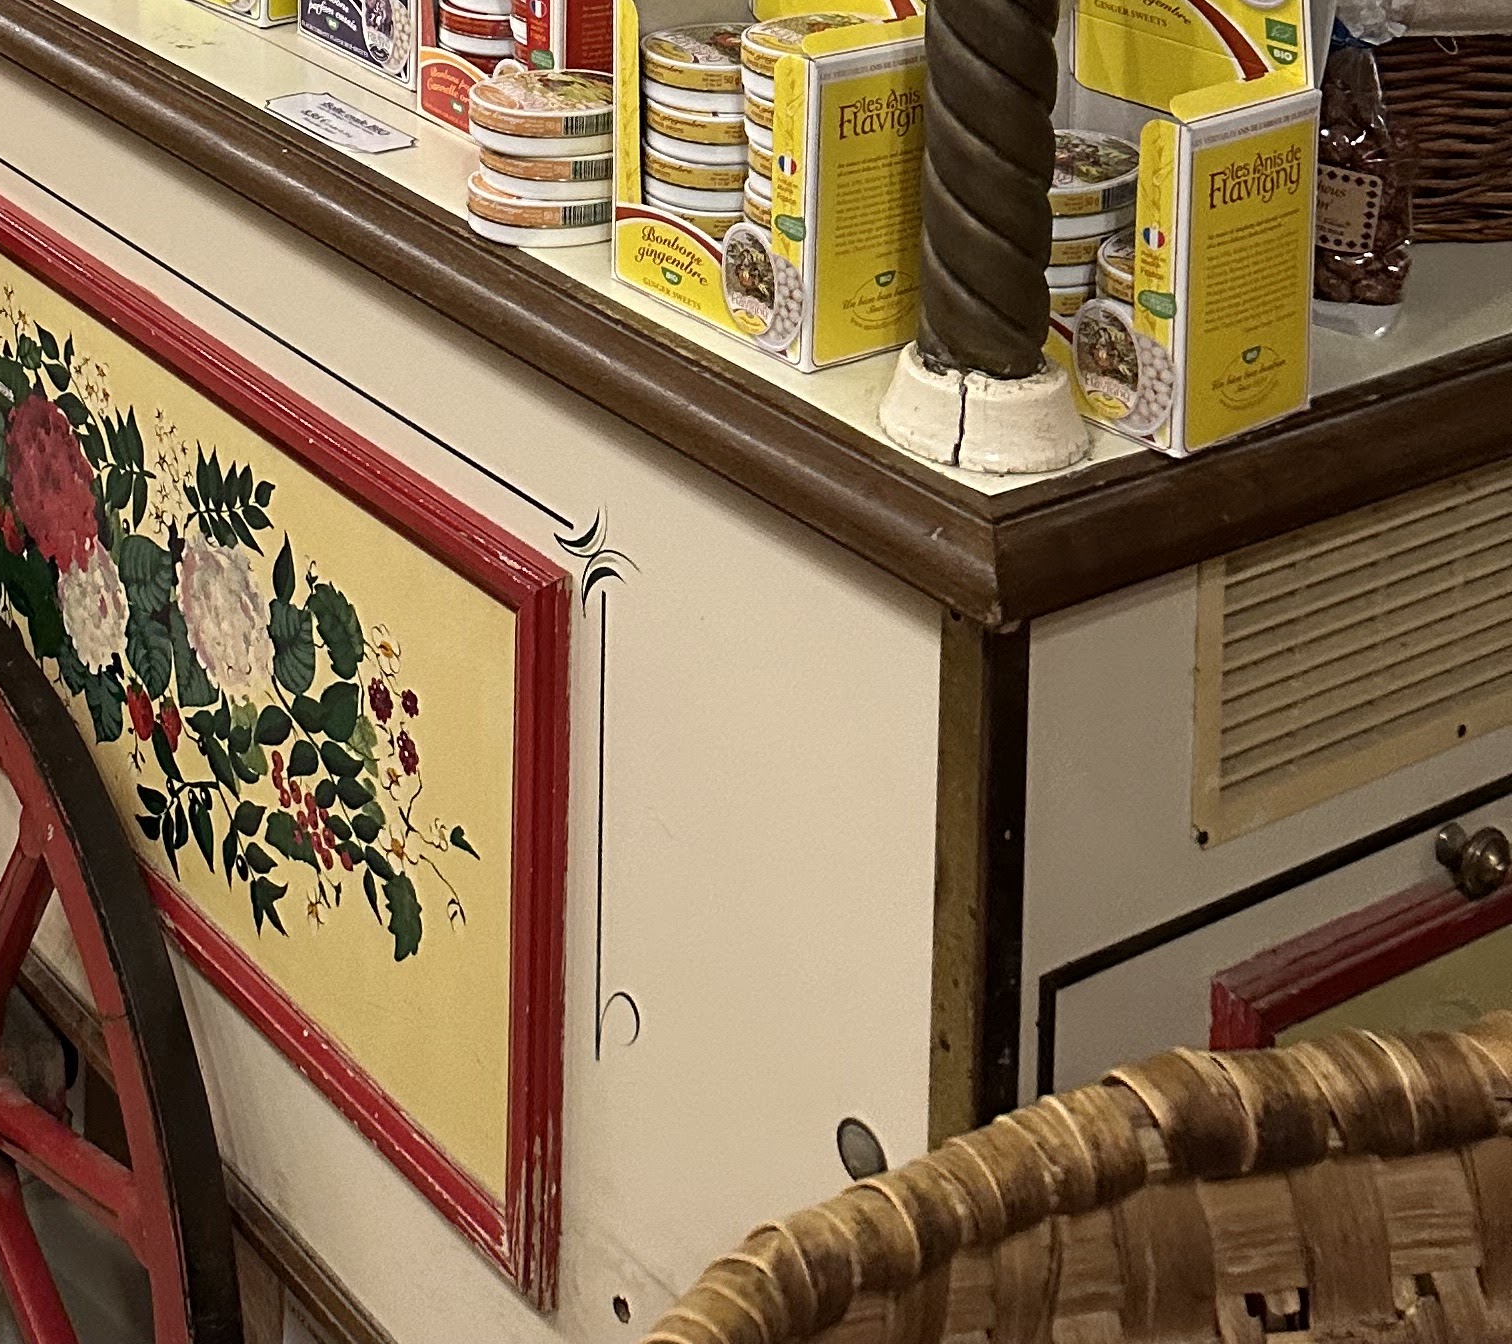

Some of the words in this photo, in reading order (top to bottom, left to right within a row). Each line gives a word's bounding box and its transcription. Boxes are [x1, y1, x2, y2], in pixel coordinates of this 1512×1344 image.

[1129, 7, 1169, 28] SWEETS
[1273, 48, 1293, 62] BIO
[861, 94, 882, 113] les
[886, 87, 920, 112] Anis
[838, 100, 924, 141] Flavign
[1228, 161, 1250, 180] les
[1253, 150, 1283, 175] Anis
[1285, 143, 1302, 164] de
[1208, 161, 1302, 210] Flavigny
[641, 224, 703, 268] Bonbons
[634, 243, 709, 287] gingembre
[664, 270, 679, 283] BIO
[671, 290, 703, 312] SWEETS
